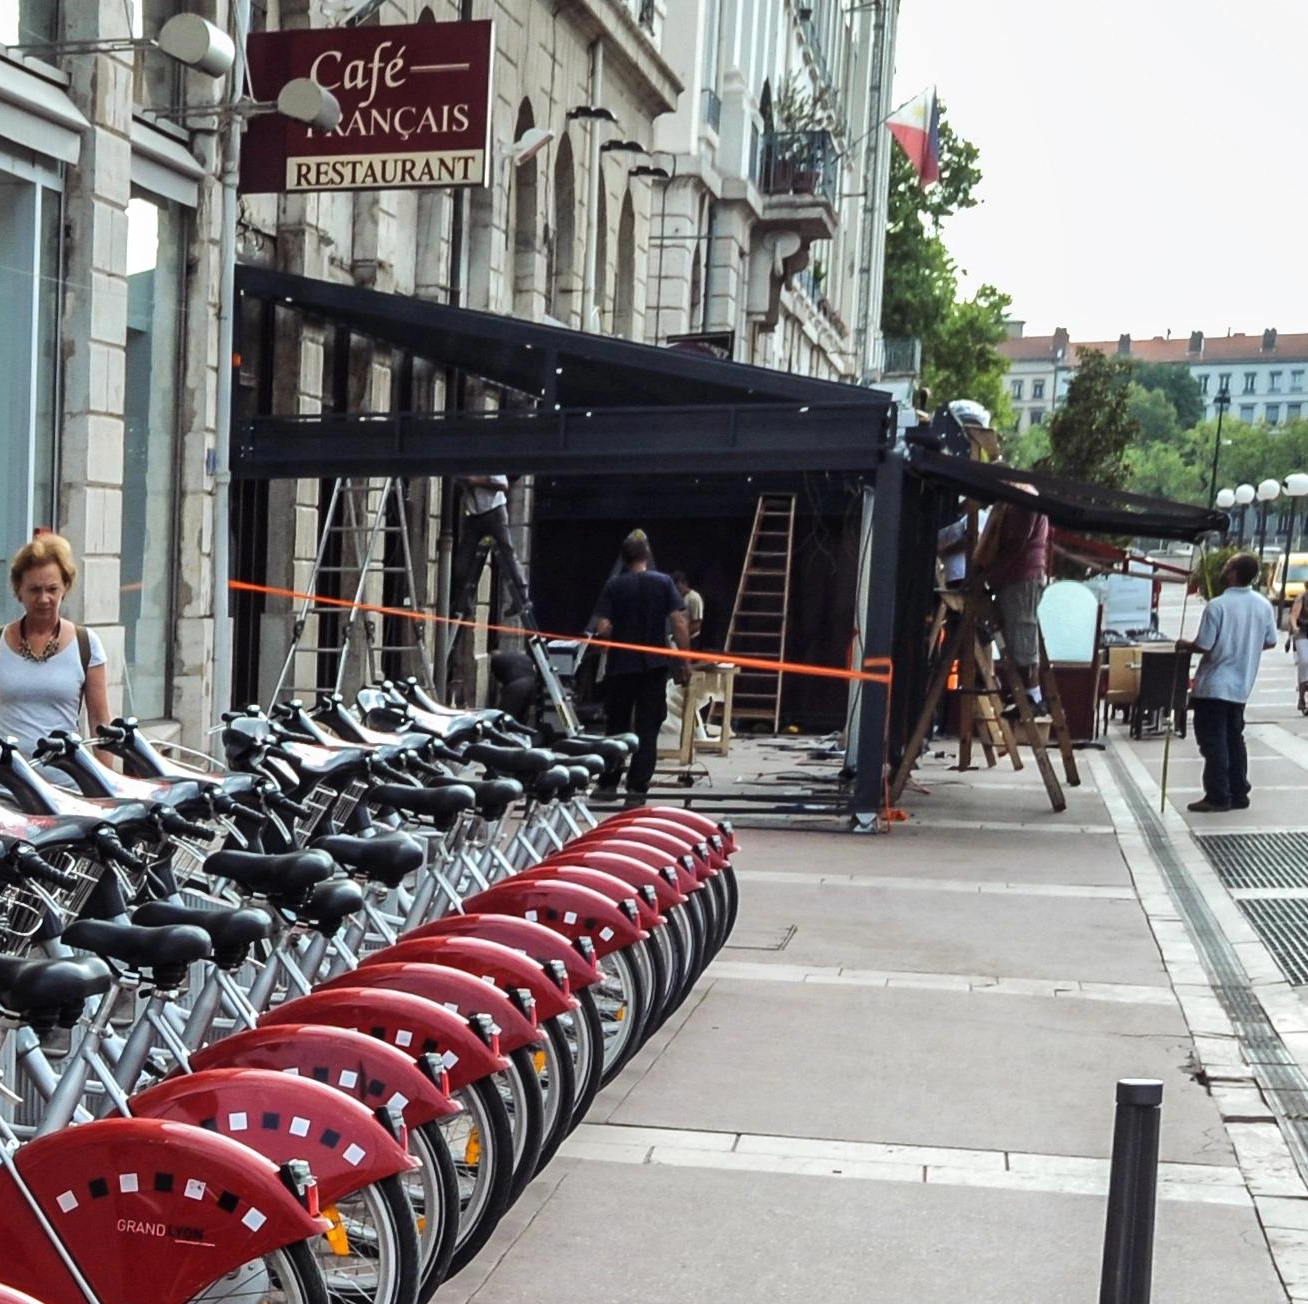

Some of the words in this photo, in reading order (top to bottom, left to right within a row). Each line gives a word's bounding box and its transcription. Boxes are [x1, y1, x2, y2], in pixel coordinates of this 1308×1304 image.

[310, 41, 407, 108] Café
[306, 104, 469, 140] RANÇAIS
[295, 155, 476, 187] RESTAURANT
